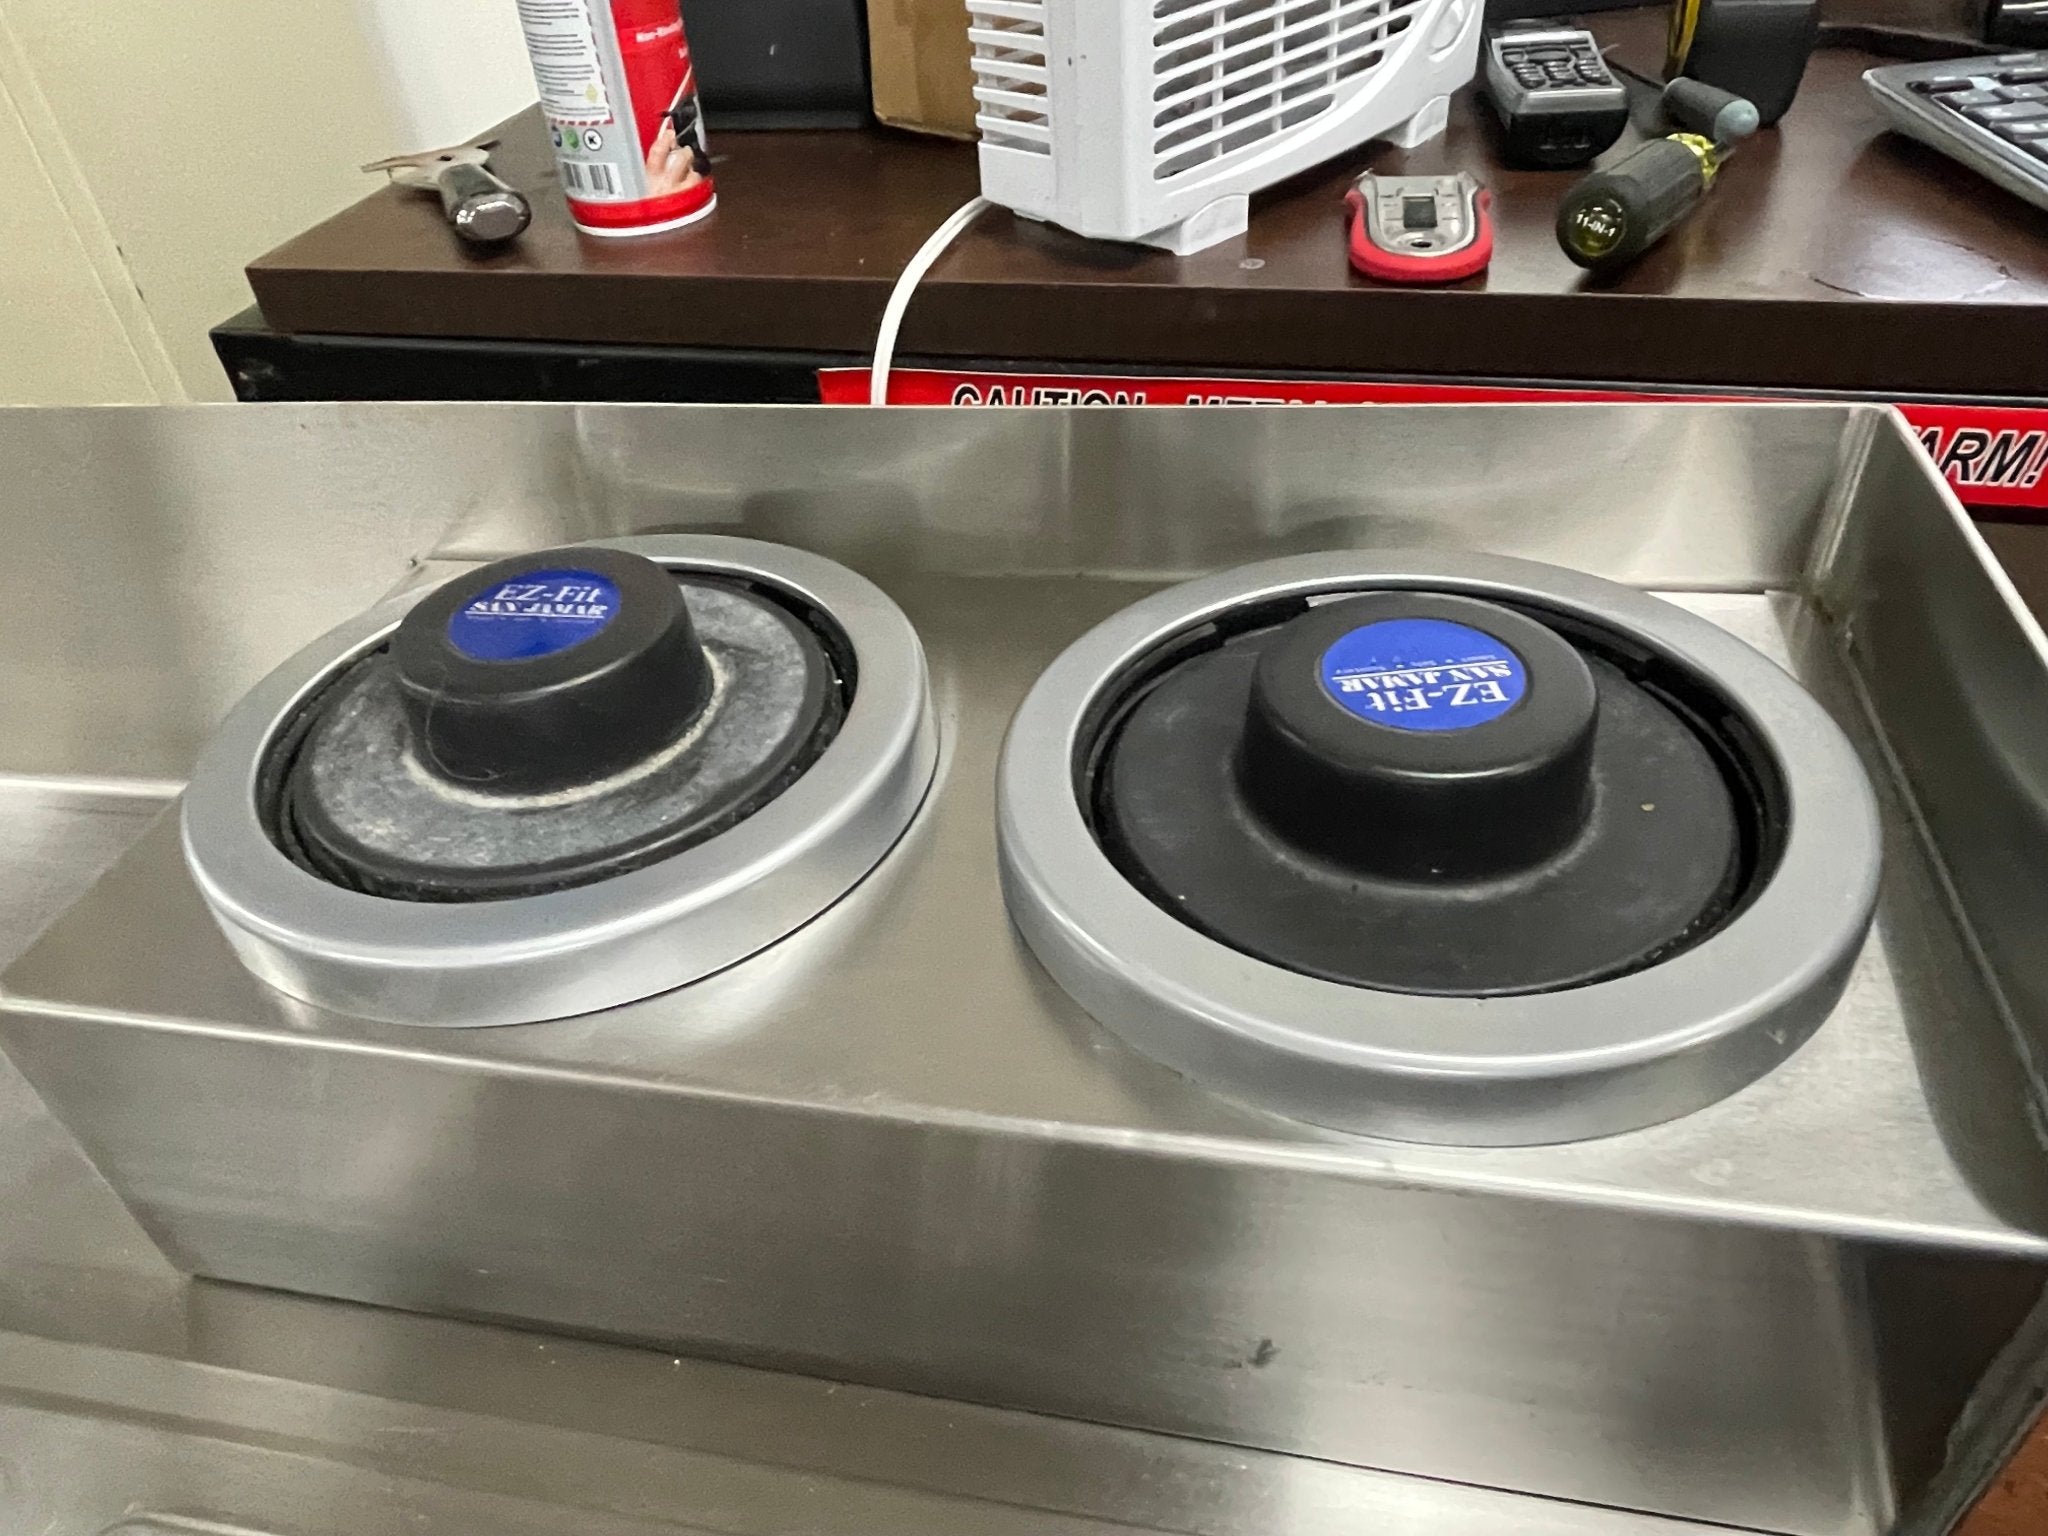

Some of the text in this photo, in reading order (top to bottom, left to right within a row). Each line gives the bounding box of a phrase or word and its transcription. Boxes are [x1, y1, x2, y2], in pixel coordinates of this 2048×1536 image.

[1576, 213, 1616, 237] 11-IN-1
[496, 584, 602, 602] EZ-Fit
[1339, 671, 1441, 693] JAMAR
[1449, 664, 1512, 681] SAN
[1365, 681, 1510, 712] EZ-Fit
